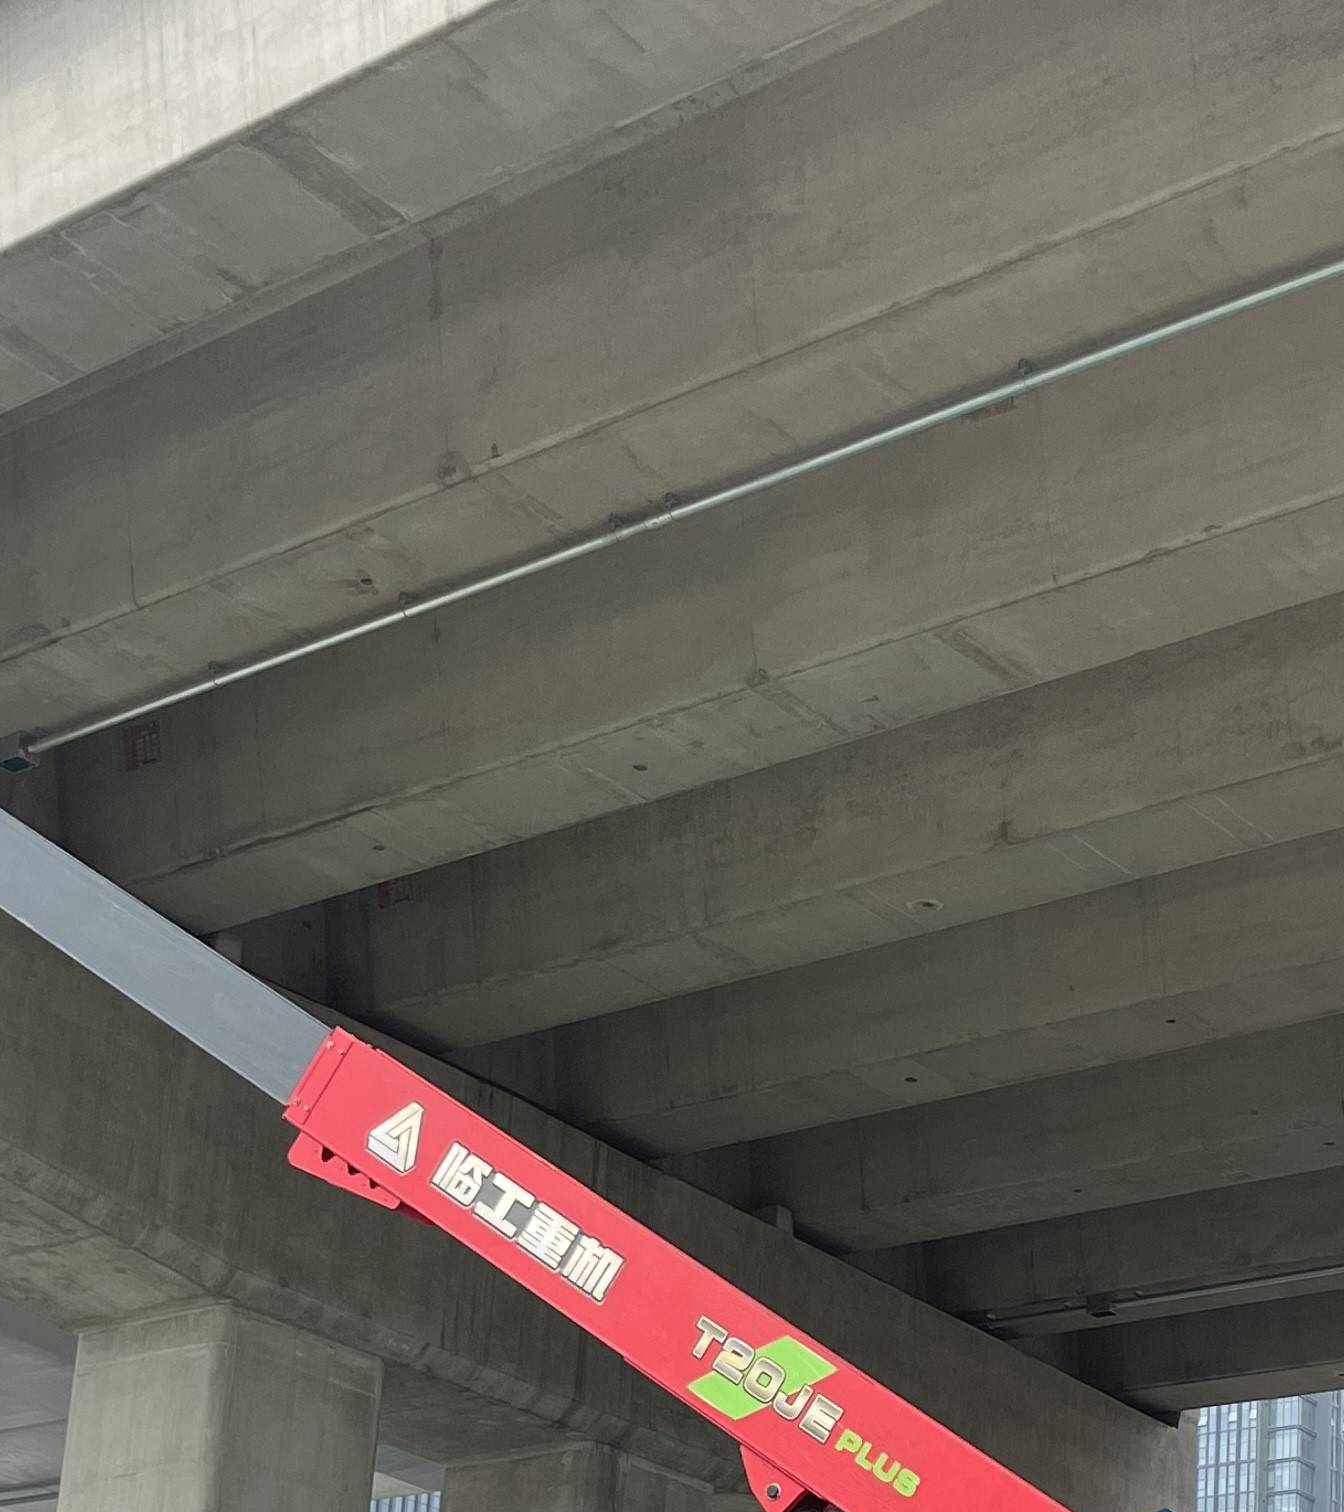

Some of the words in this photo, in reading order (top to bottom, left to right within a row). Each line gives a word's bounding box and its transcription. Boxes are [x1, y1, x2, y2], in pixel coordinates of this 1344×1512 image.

[431, 1140, 626, 1303] 临工重机
[691, 1315, 845, 1444] T20JE
[834, 1428, 921, 1498] PLUS
